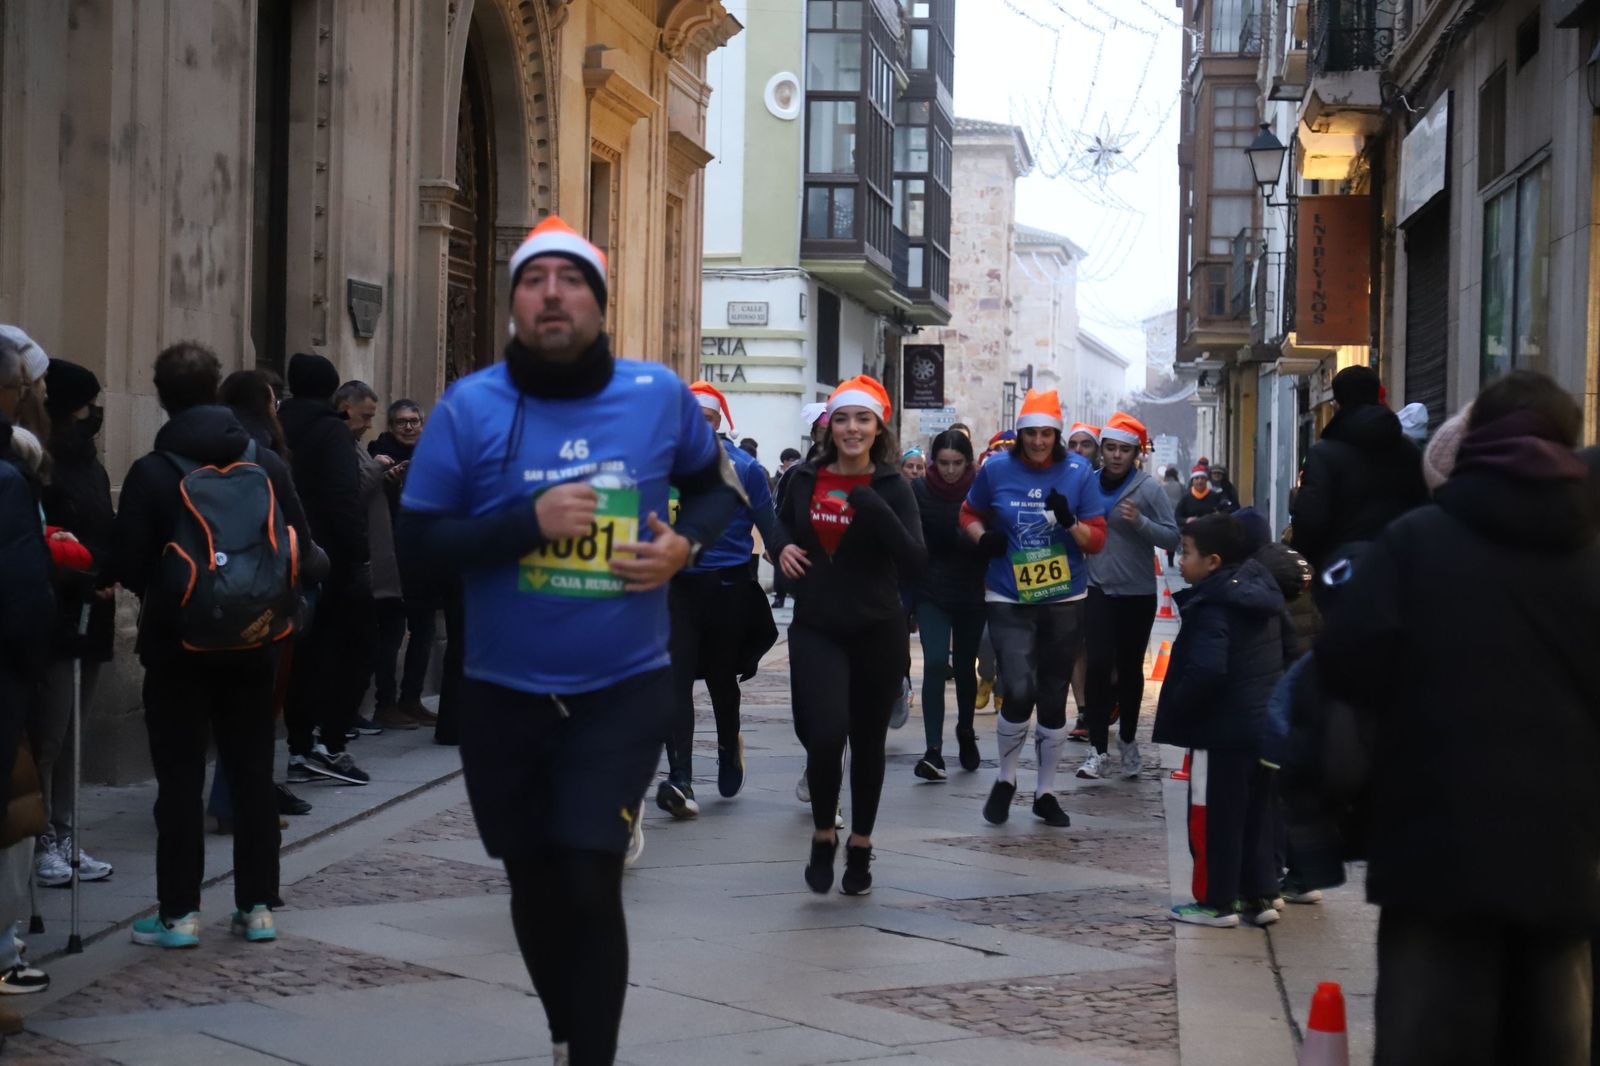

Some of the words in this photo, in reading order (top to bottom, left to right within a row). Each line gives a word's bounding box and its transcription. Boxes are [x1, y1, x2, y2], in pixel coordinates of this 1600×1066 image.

[1311, 212, 1327, 325] ENTREVINOS
[559, 438, 590, 461] 46
[523, 469, 544, 482] SAN
[1027, 488, 1042, 499] 46
[821, 512, 837, 523] THE
[1019, 559, 1062, 586] 426
[551, 575, 582, 590] CAJA
